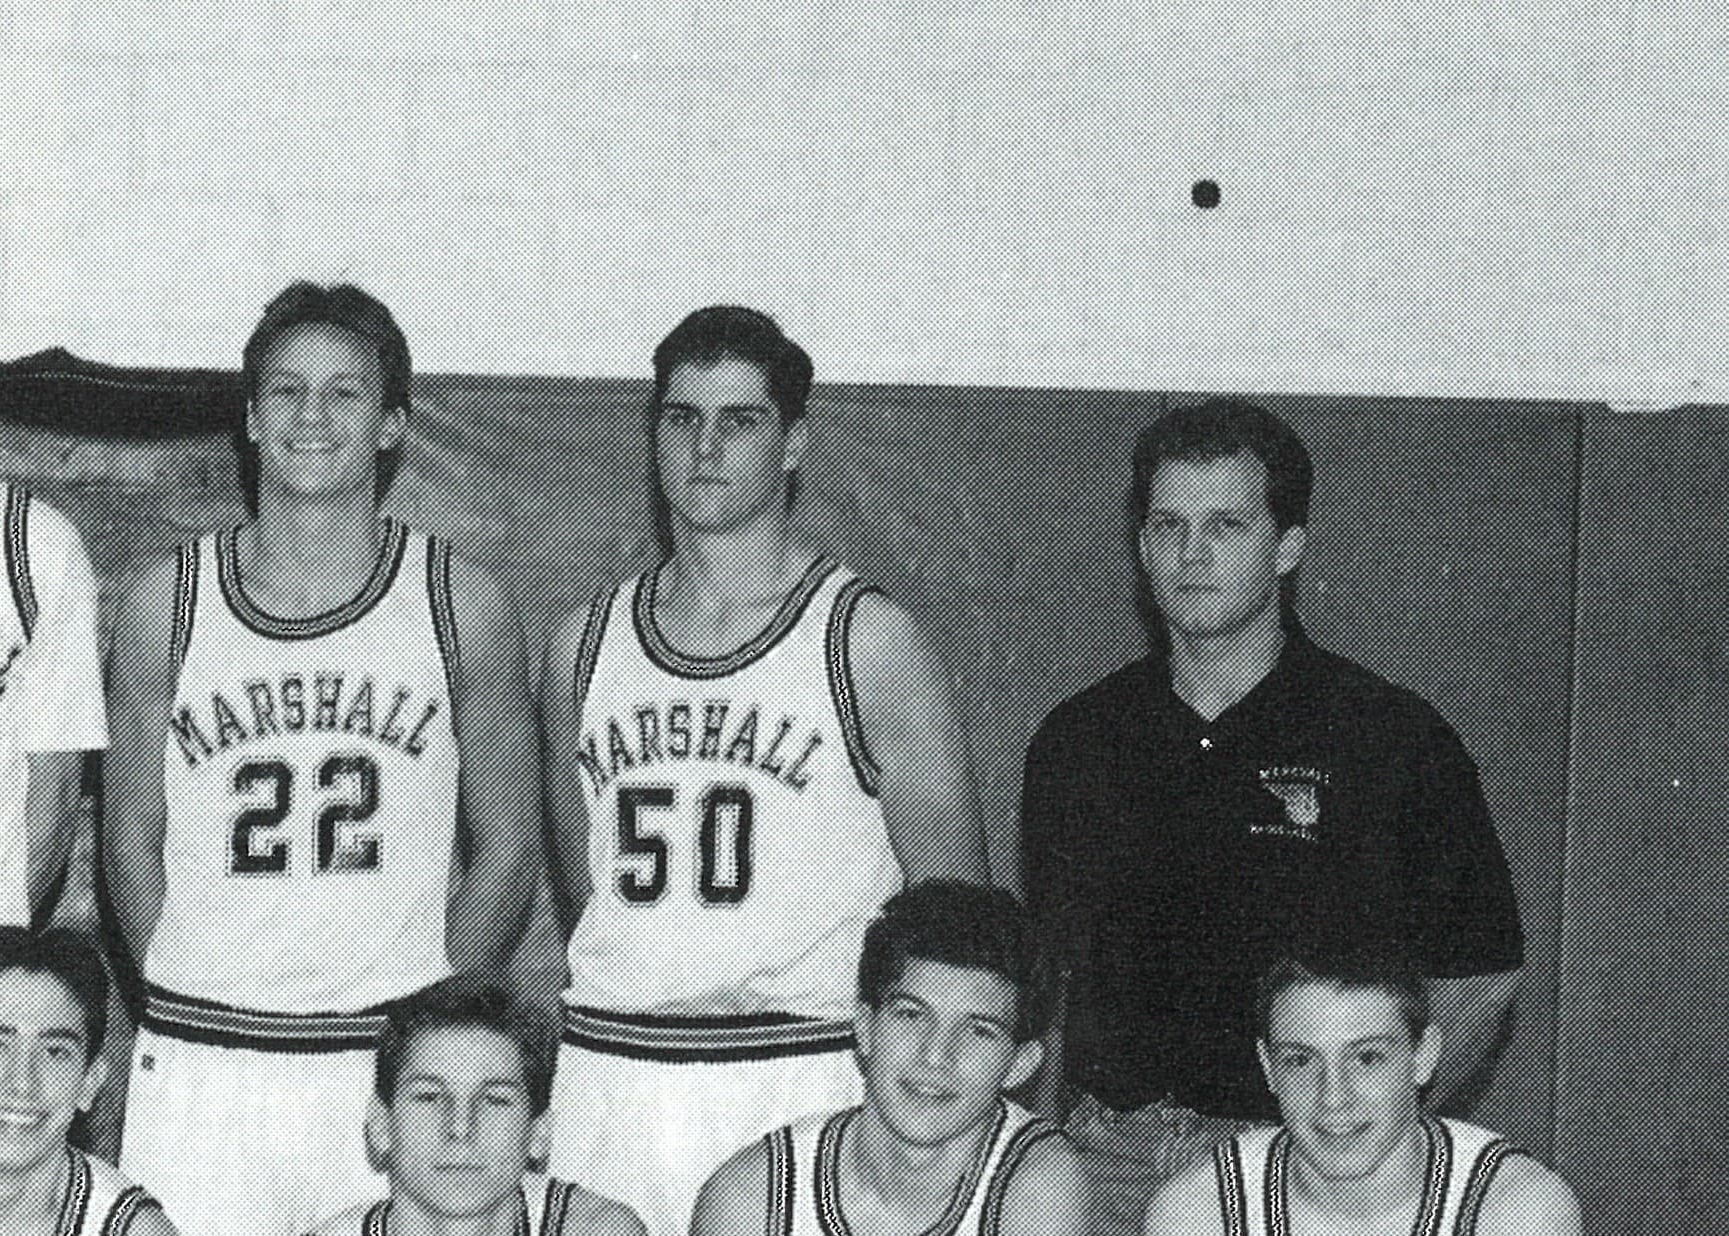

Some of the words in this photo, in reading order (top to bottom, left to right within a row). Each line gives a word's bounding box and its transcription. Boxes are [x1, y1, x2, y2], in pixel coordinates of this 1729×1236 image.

[170, 672, 443, 767] MARSHALL
[576, 703, 826, 796] MARSHALL
[227, 752, 383, 876] 22
[614, 782, 755, 906] 50
